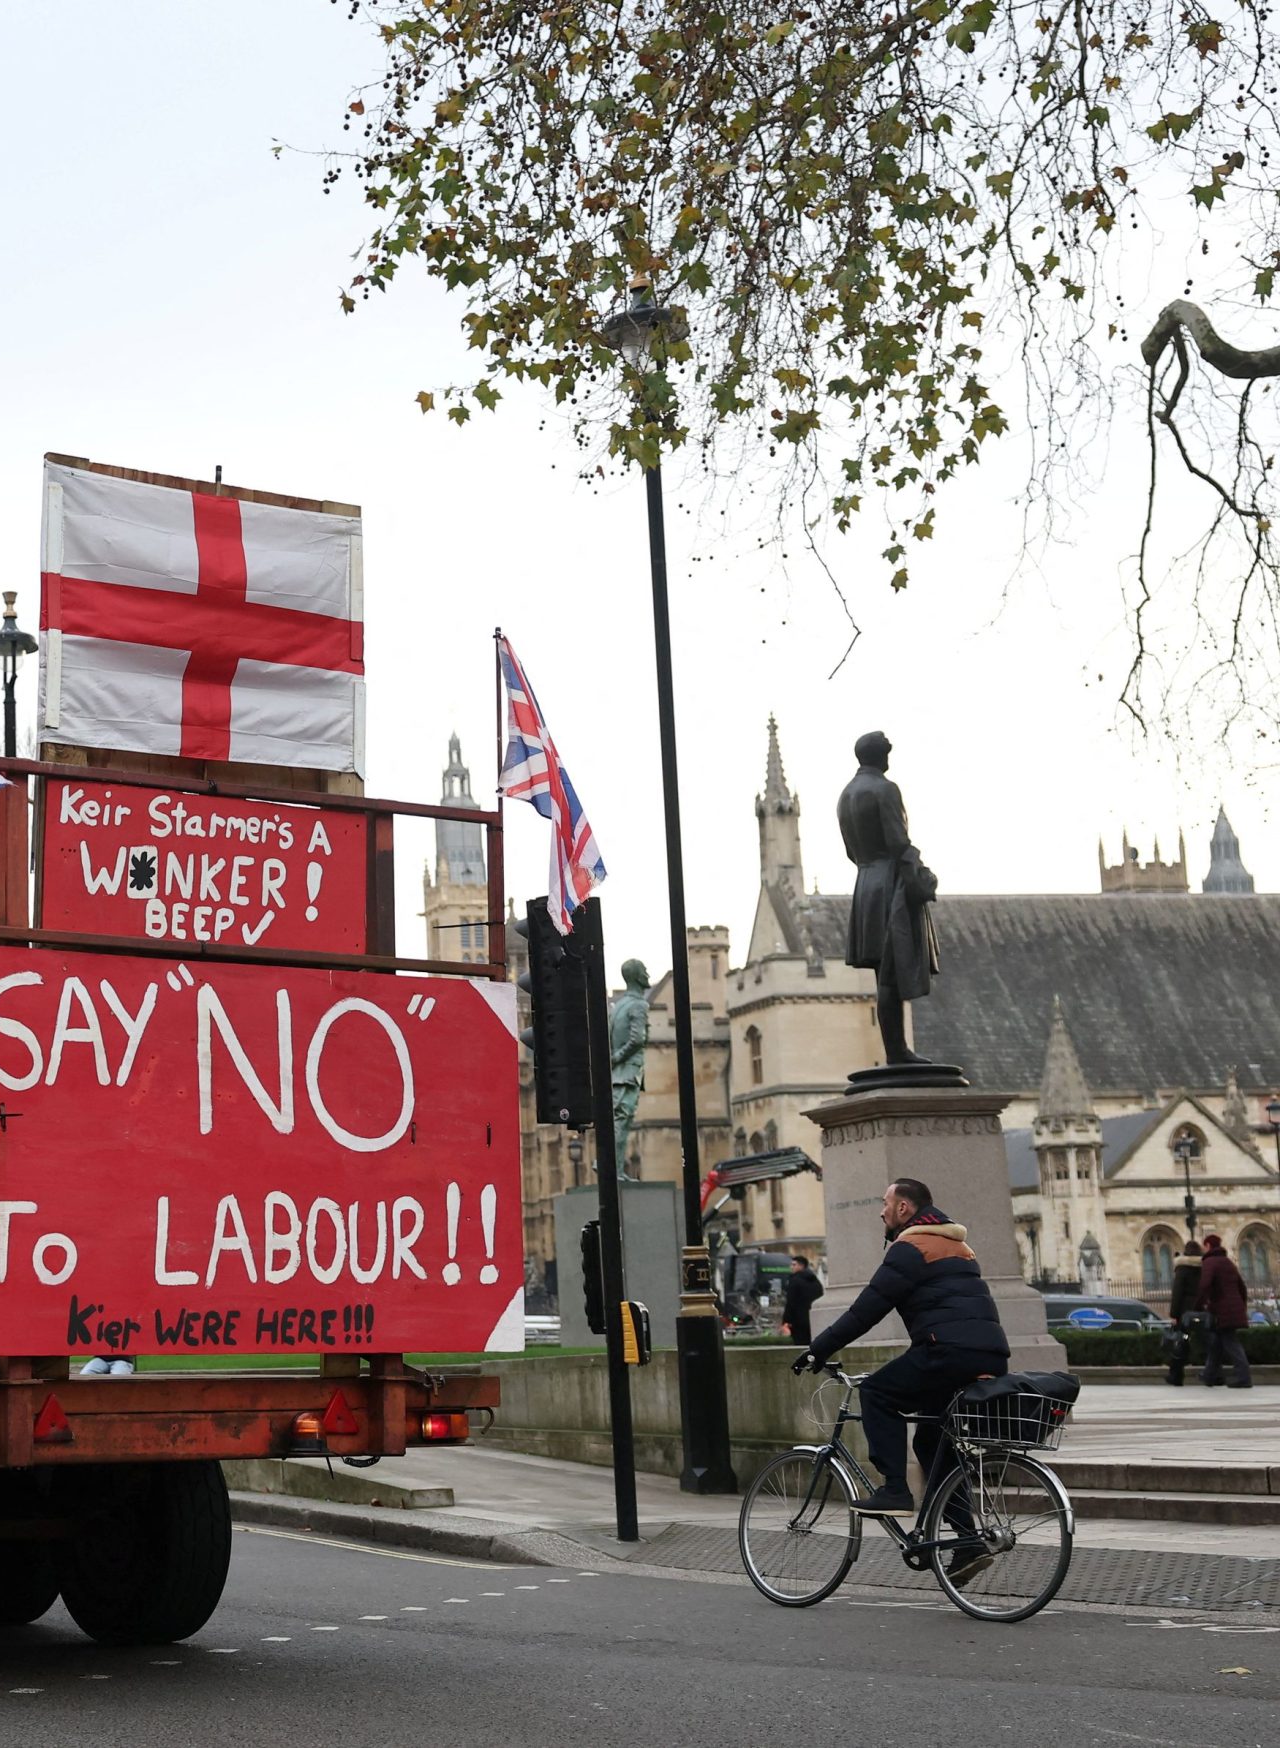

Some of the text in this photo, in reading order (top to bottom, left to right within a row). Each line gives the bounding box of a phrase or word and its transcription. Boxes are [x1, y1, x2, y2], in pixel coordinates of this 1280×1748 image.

[60, 785, 331, 855] Keir Starmer's A
[81, 841, 323, 922] WNKER!
[145, 900, 236, 940] BEEP
[155, 1182, 499, 1286] LABOUR!!
[67, 1295, 374, 1350] Kier WERE HERE!!!
